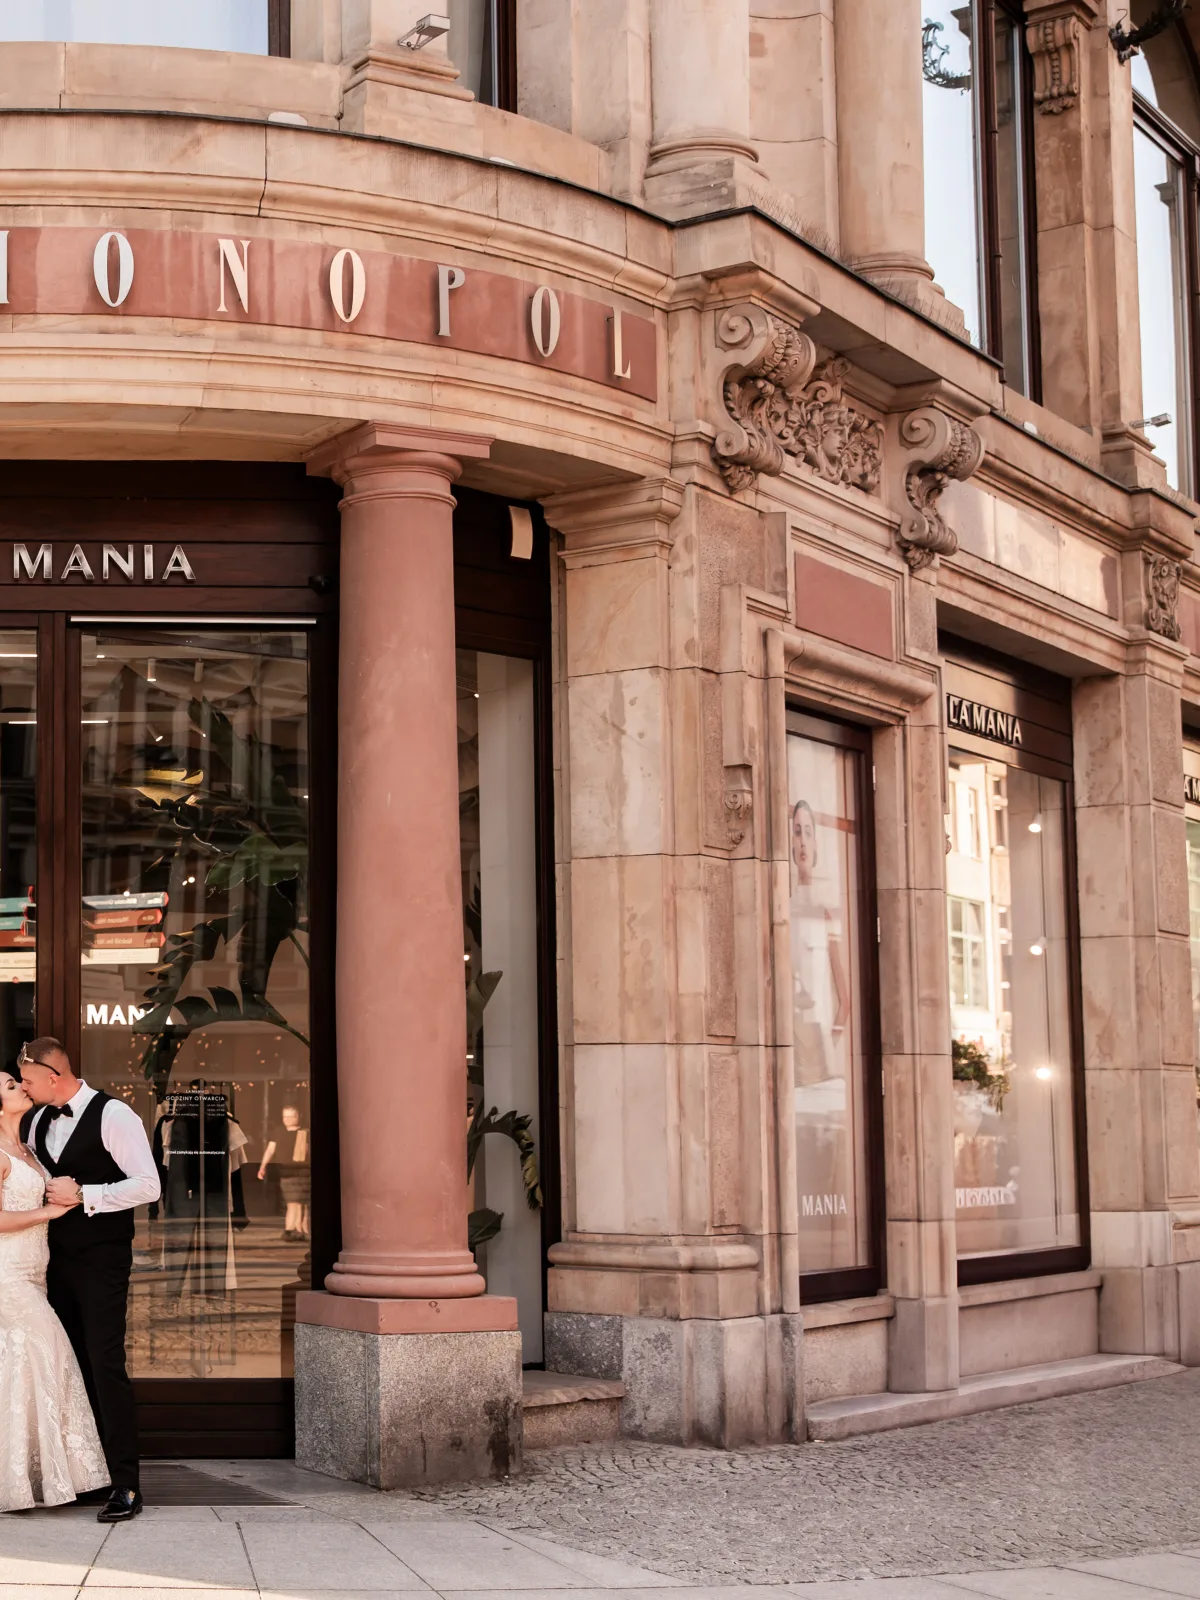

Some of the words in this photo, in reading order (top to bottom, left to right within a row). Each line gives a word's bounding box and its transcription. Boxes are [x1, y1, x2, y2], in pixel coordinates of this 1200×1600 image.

[12, 542, 197, 582] MANIA
[948, 695, 970, 728] LA
[972, 702, 1023, 745] MANIA
[86, 1003, 173, 1025] MAN
[801, 1193, 848, 1217] MANIA
